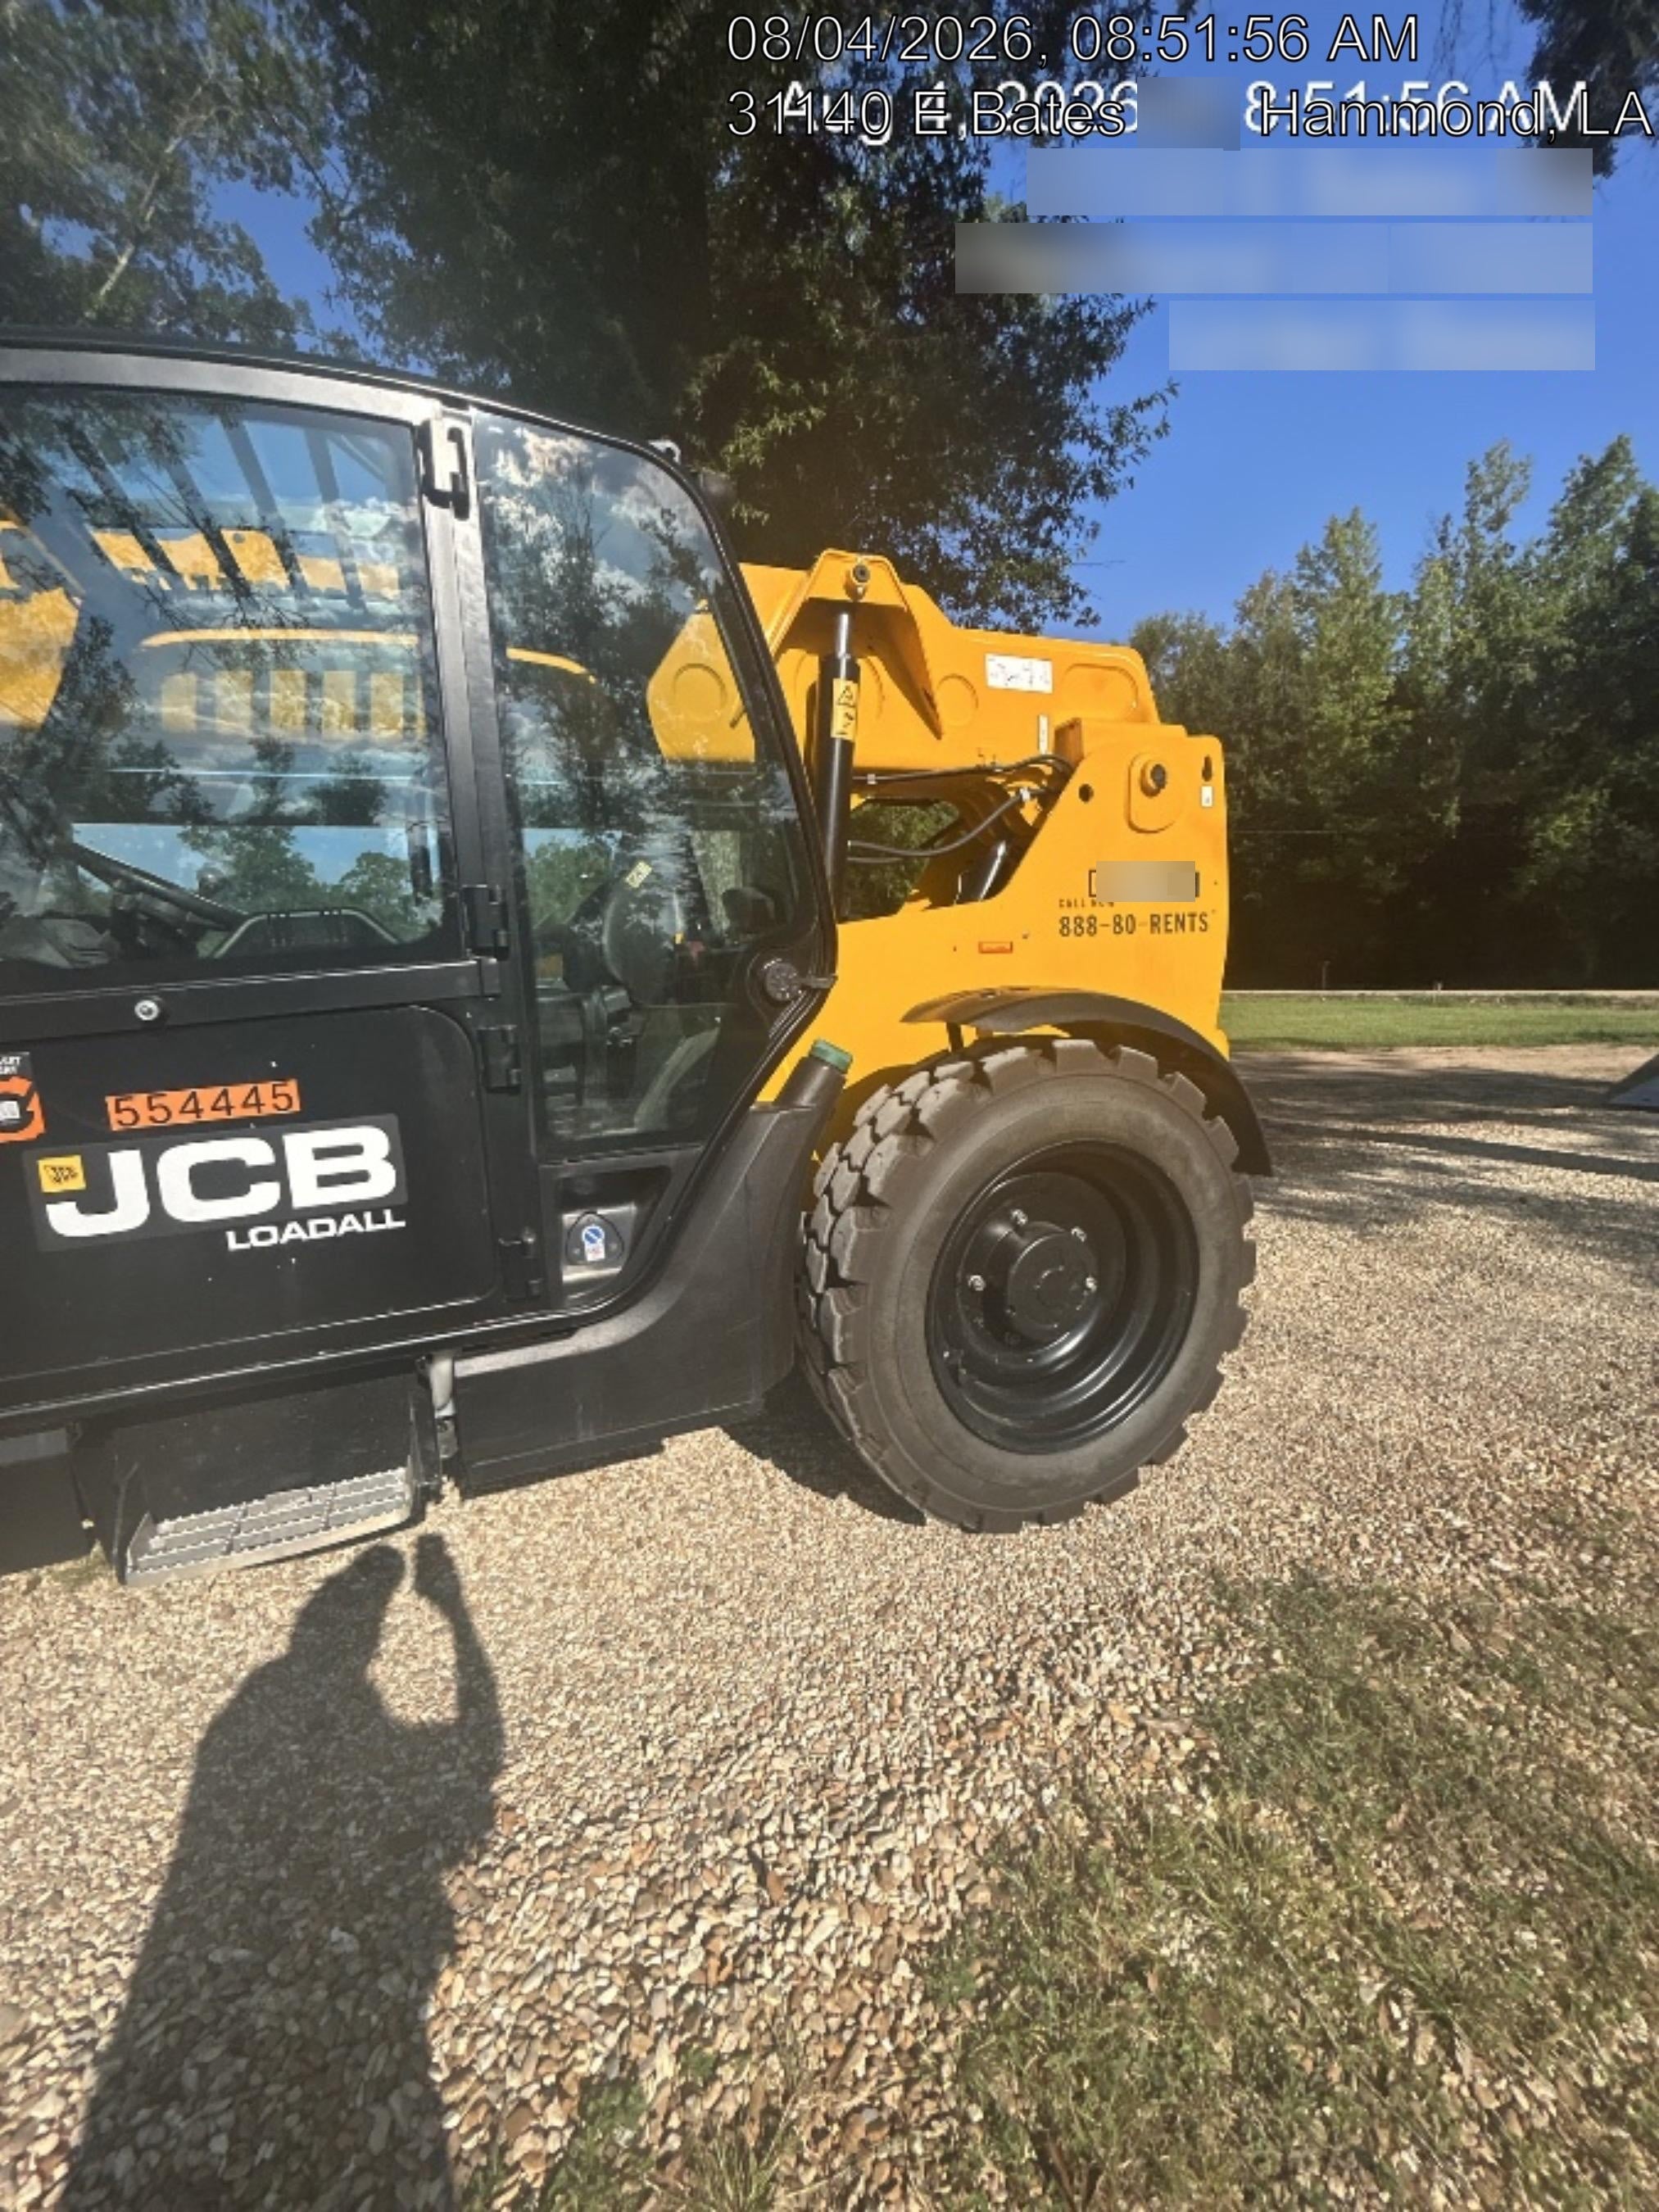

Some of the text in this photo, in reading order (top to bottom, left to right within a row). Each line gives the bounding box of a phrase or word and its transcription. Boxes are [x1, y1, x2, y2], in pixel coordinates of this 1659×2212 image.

[113, 1081, 294, 1128] 554445
[45, 1126, 397, 1238] JCB
[225, 1208, 407, 1251] LOADALL
